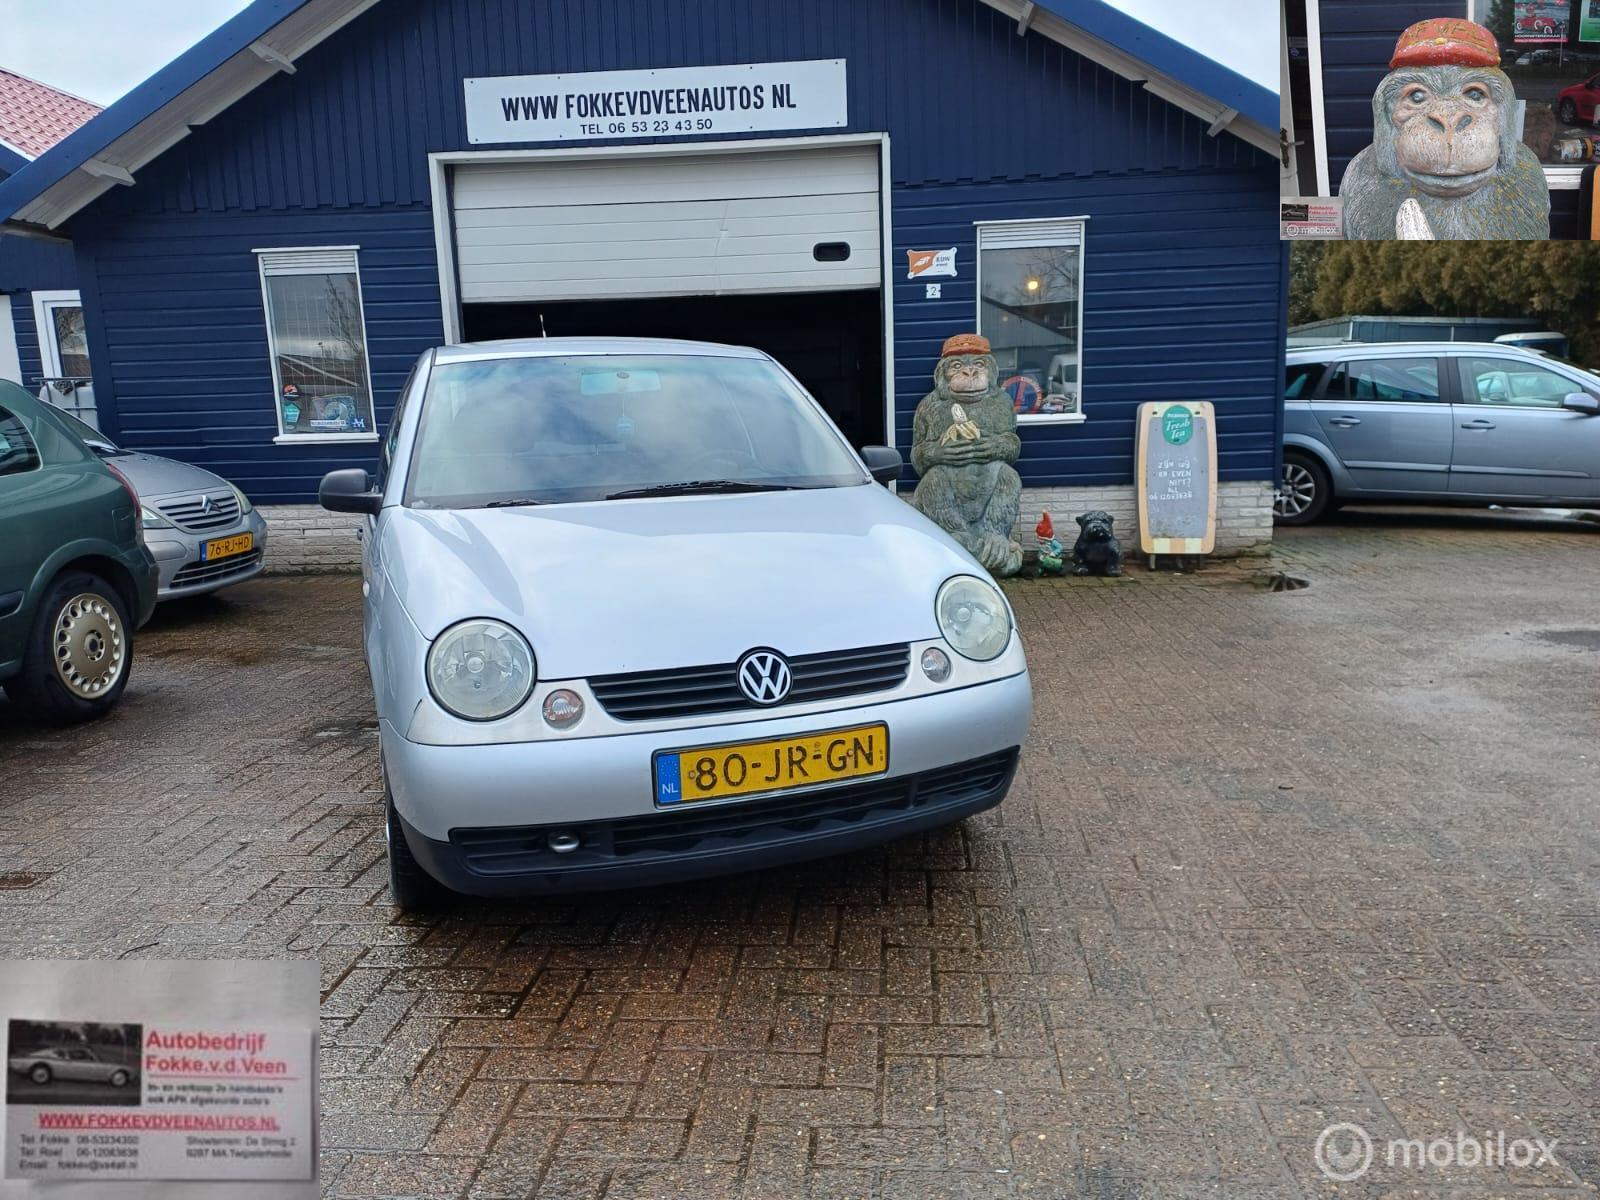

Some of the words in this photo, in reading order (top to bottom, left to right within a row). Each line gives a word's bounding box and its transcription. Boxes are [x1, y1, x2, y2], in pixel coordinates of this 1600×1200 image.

[501, 95, 558, 121] WWW
[565, 85, 764, 119] FOKKEVDVEENAUTOS
[772, 84, 796, 109] NL
[580, 124, 604, 135] TEL
[608, 122, 626, 133] 06
[631, 121, 648, 132] 53
[653, 120, 669, 133] 23
[675, 119, 692, 131] 43
[696, 118, 713, 130] 50
[930, 286, 937, 296] 2
[1166, 418, 1190, 431] Fresh
[1171, 429, 1186, 440] Tea
[209, 536, 250, 557] 76-RJ-HD
[695, 734, 875, 791] 80-JR-GN
[662, 783, 679, 794] NL
